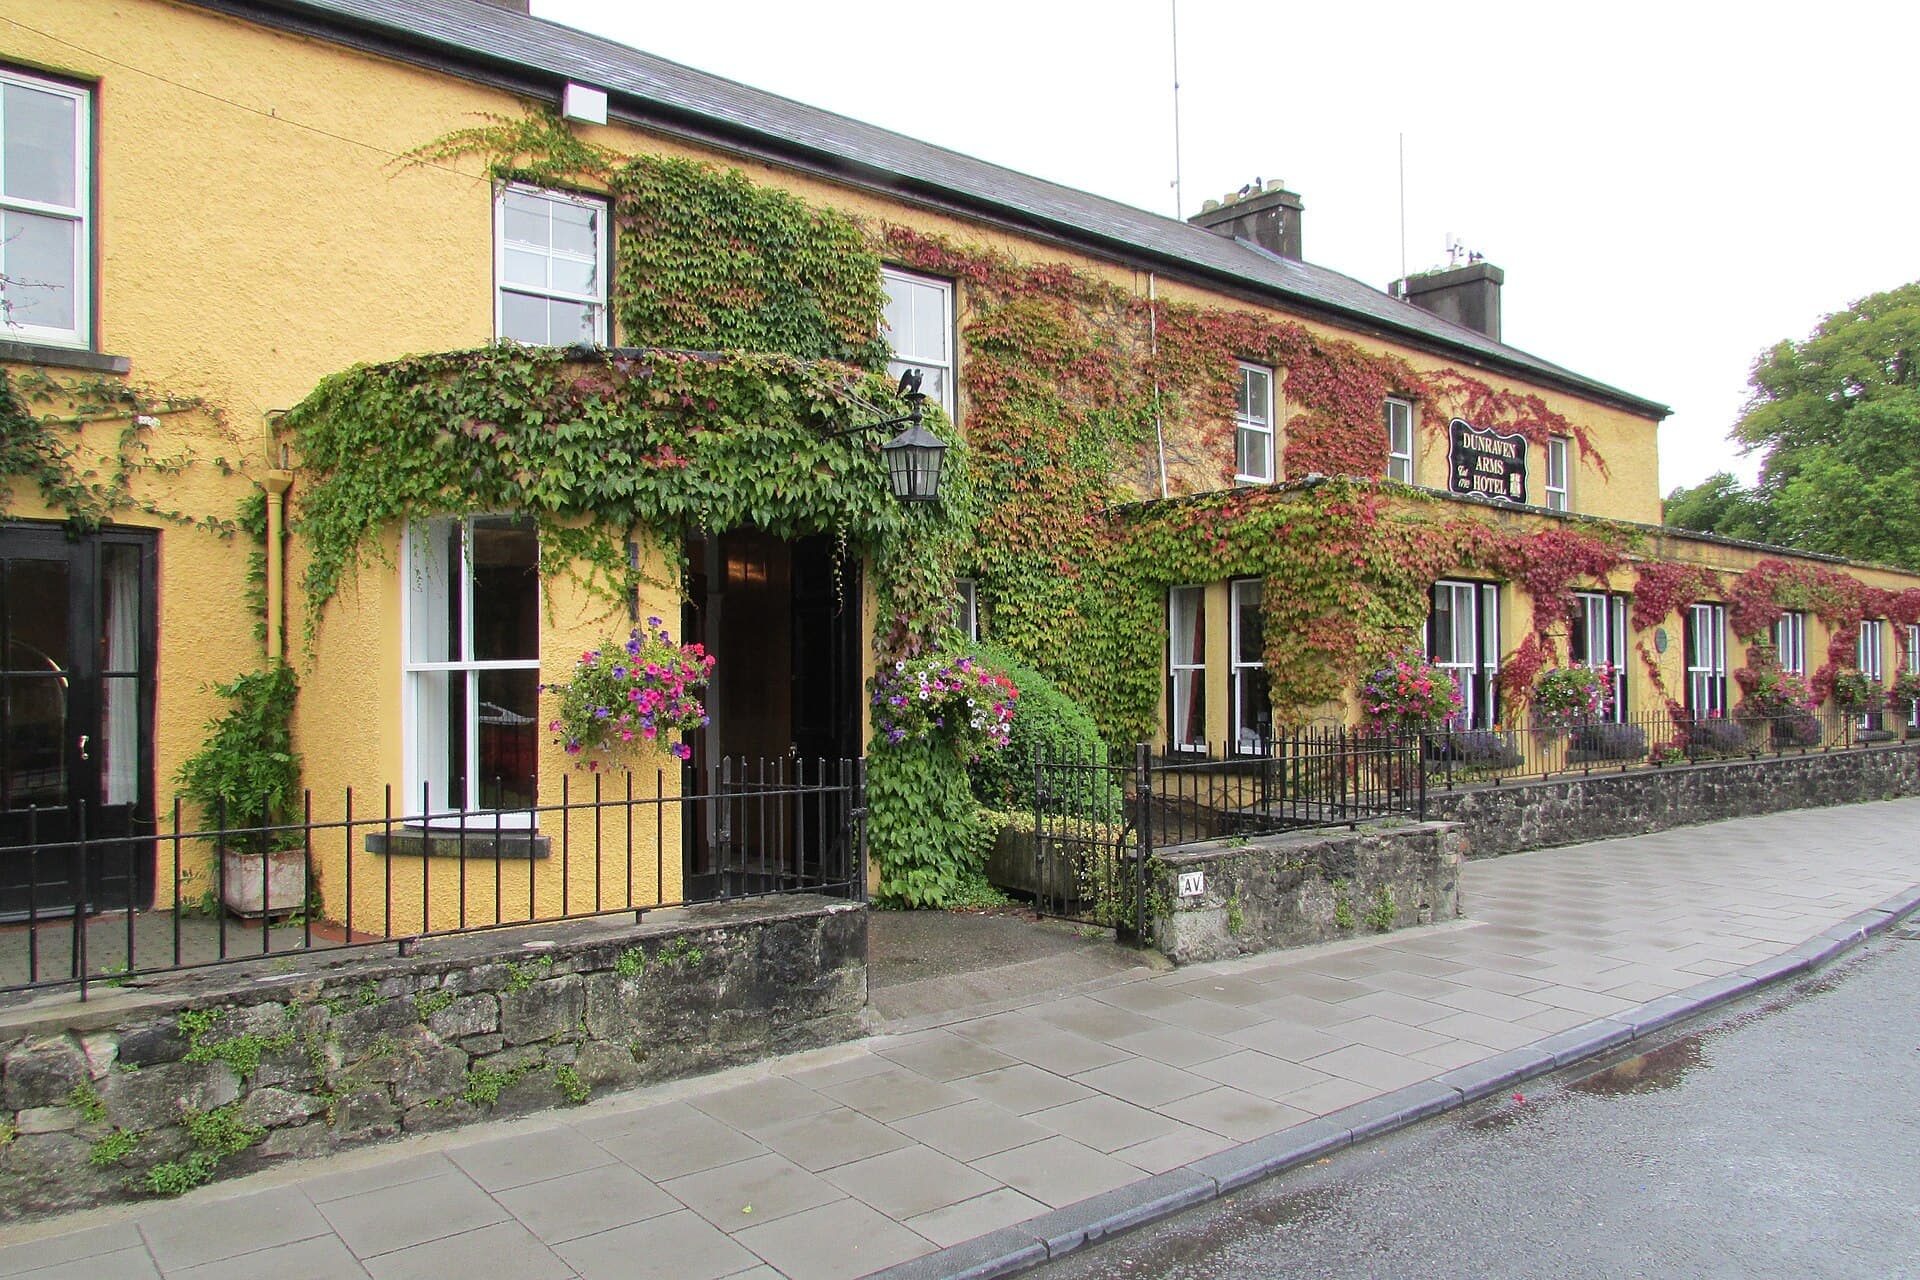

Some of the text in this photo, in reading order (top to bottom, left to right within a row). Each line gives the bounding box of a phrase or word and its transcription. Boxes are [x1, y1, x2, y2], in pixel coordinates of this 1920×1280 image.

[1463, 432, 1515, 458] DUNRAVEN
[1475, 456, 1504, 475] ARMS
[1473, 475, 1507, 495] HOTEL
[1184, 876, 1201, 893] AV
